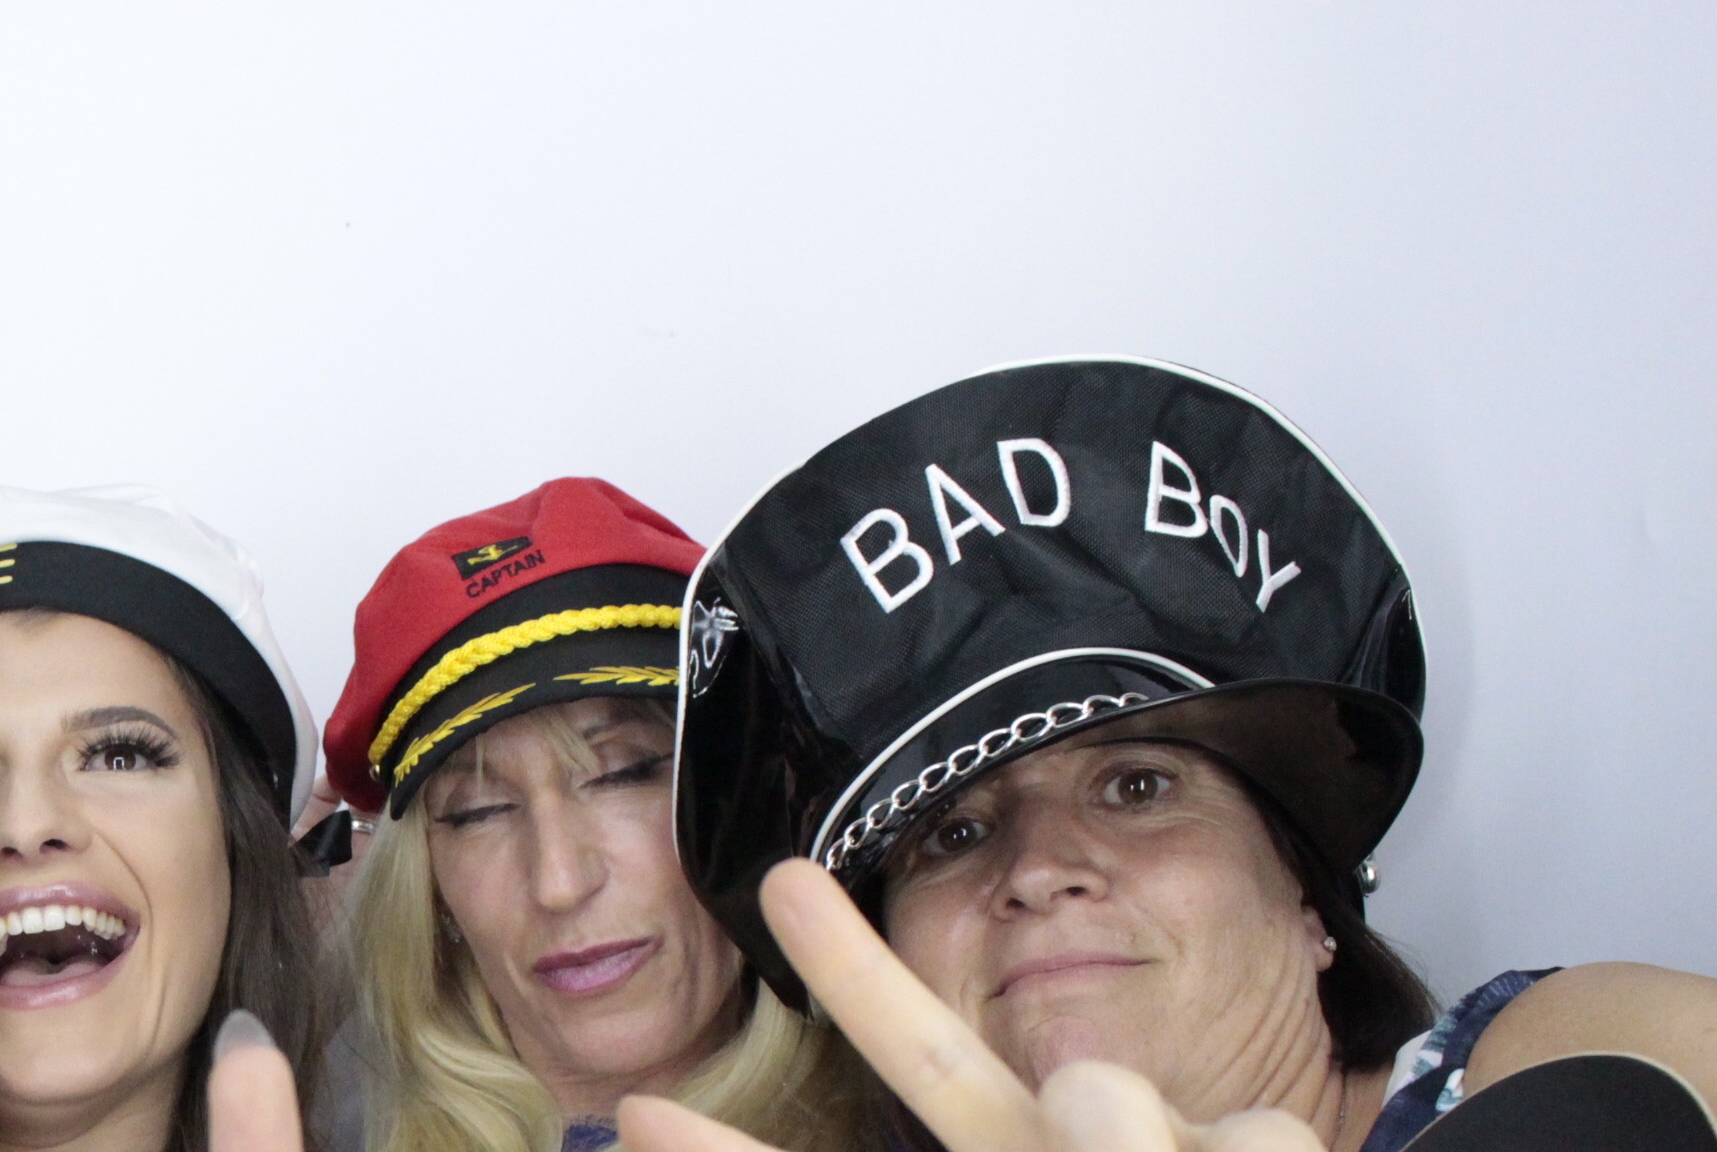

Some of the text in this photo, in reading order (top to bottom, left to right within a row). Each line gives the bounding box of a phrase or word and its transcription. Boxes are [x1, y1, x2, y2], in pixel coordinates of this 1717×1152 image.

[465, 549, 546, 598] CAPTAIN
[839, 437, 1301, 613] BAD BOY
